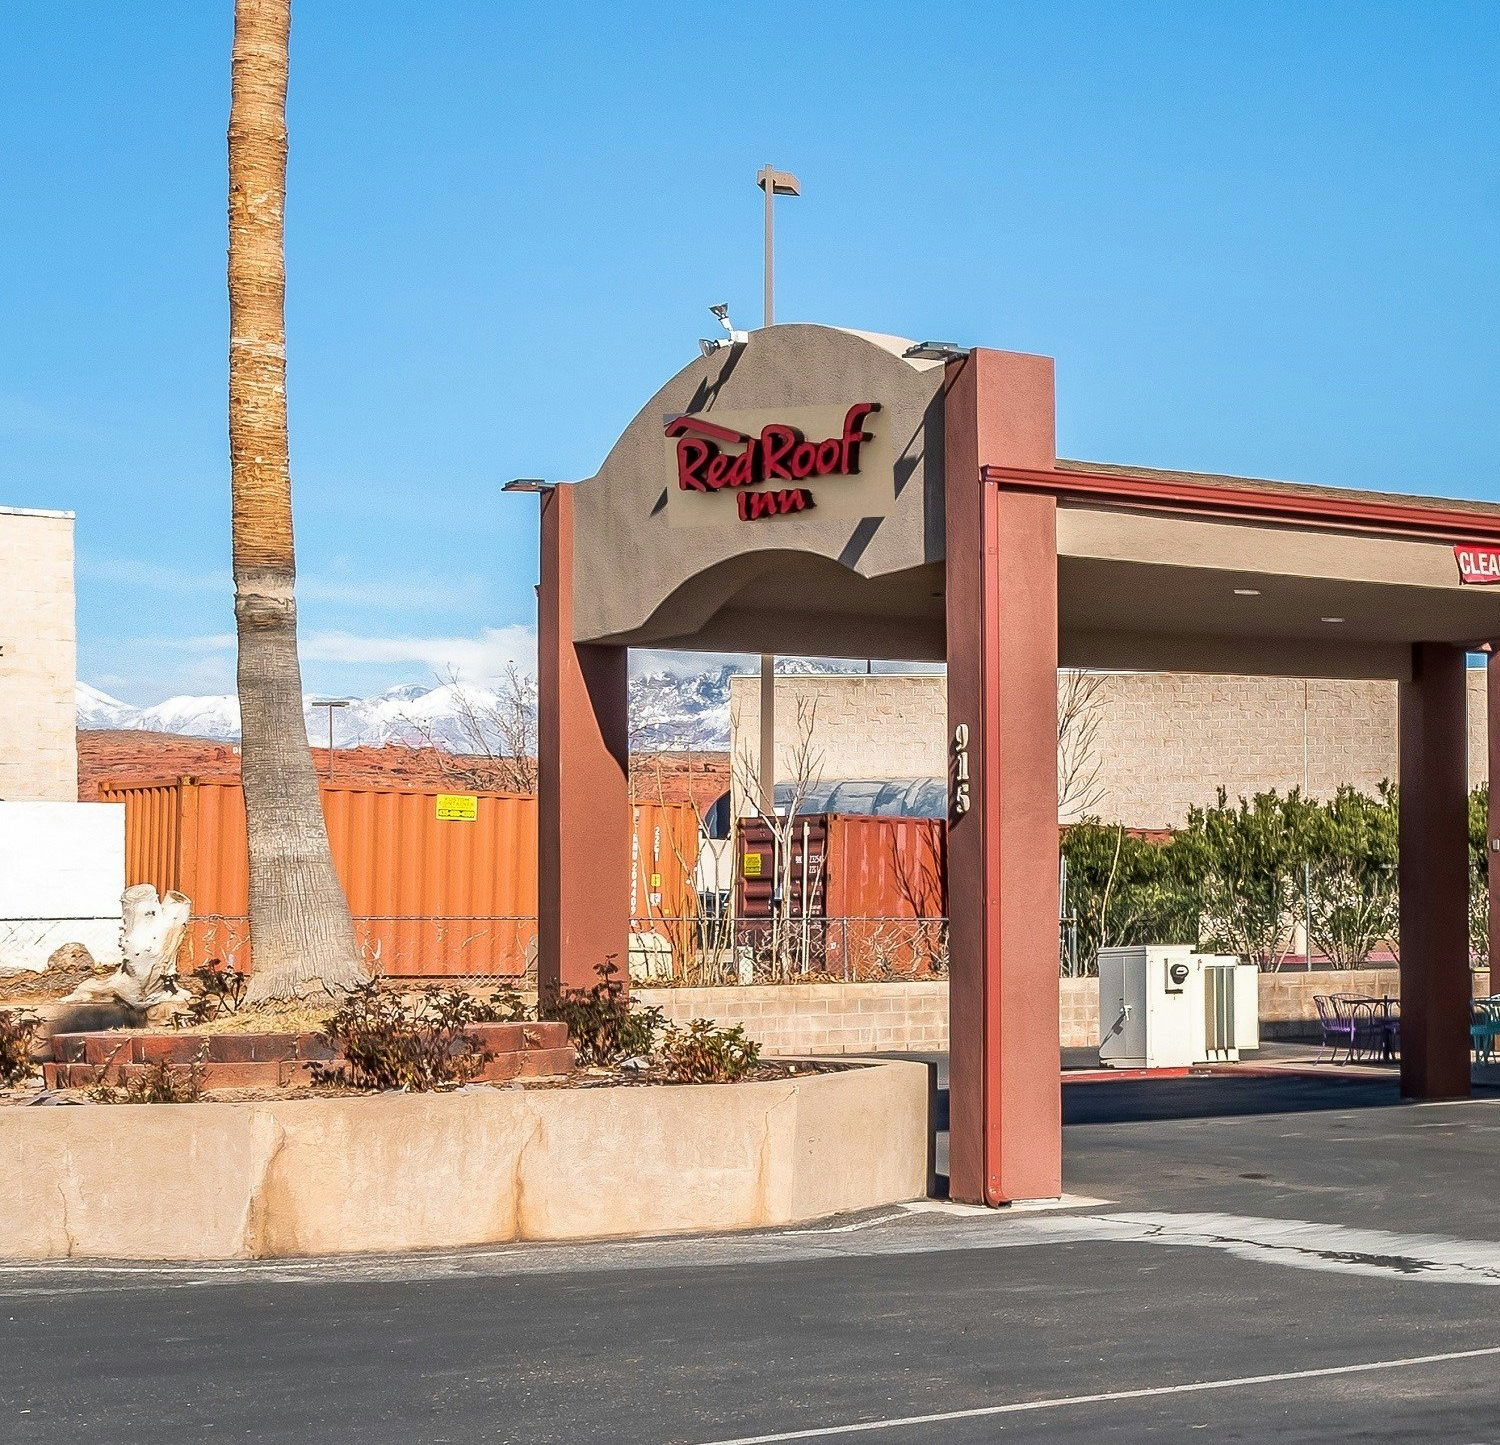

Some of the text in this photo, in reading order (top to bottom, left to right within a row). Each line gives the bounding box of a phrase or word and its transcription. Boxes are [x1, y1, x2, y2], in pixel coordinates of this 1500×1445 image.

[677, 402, 874, 492] Red Roof
[955, 723, 970, 813] 915
